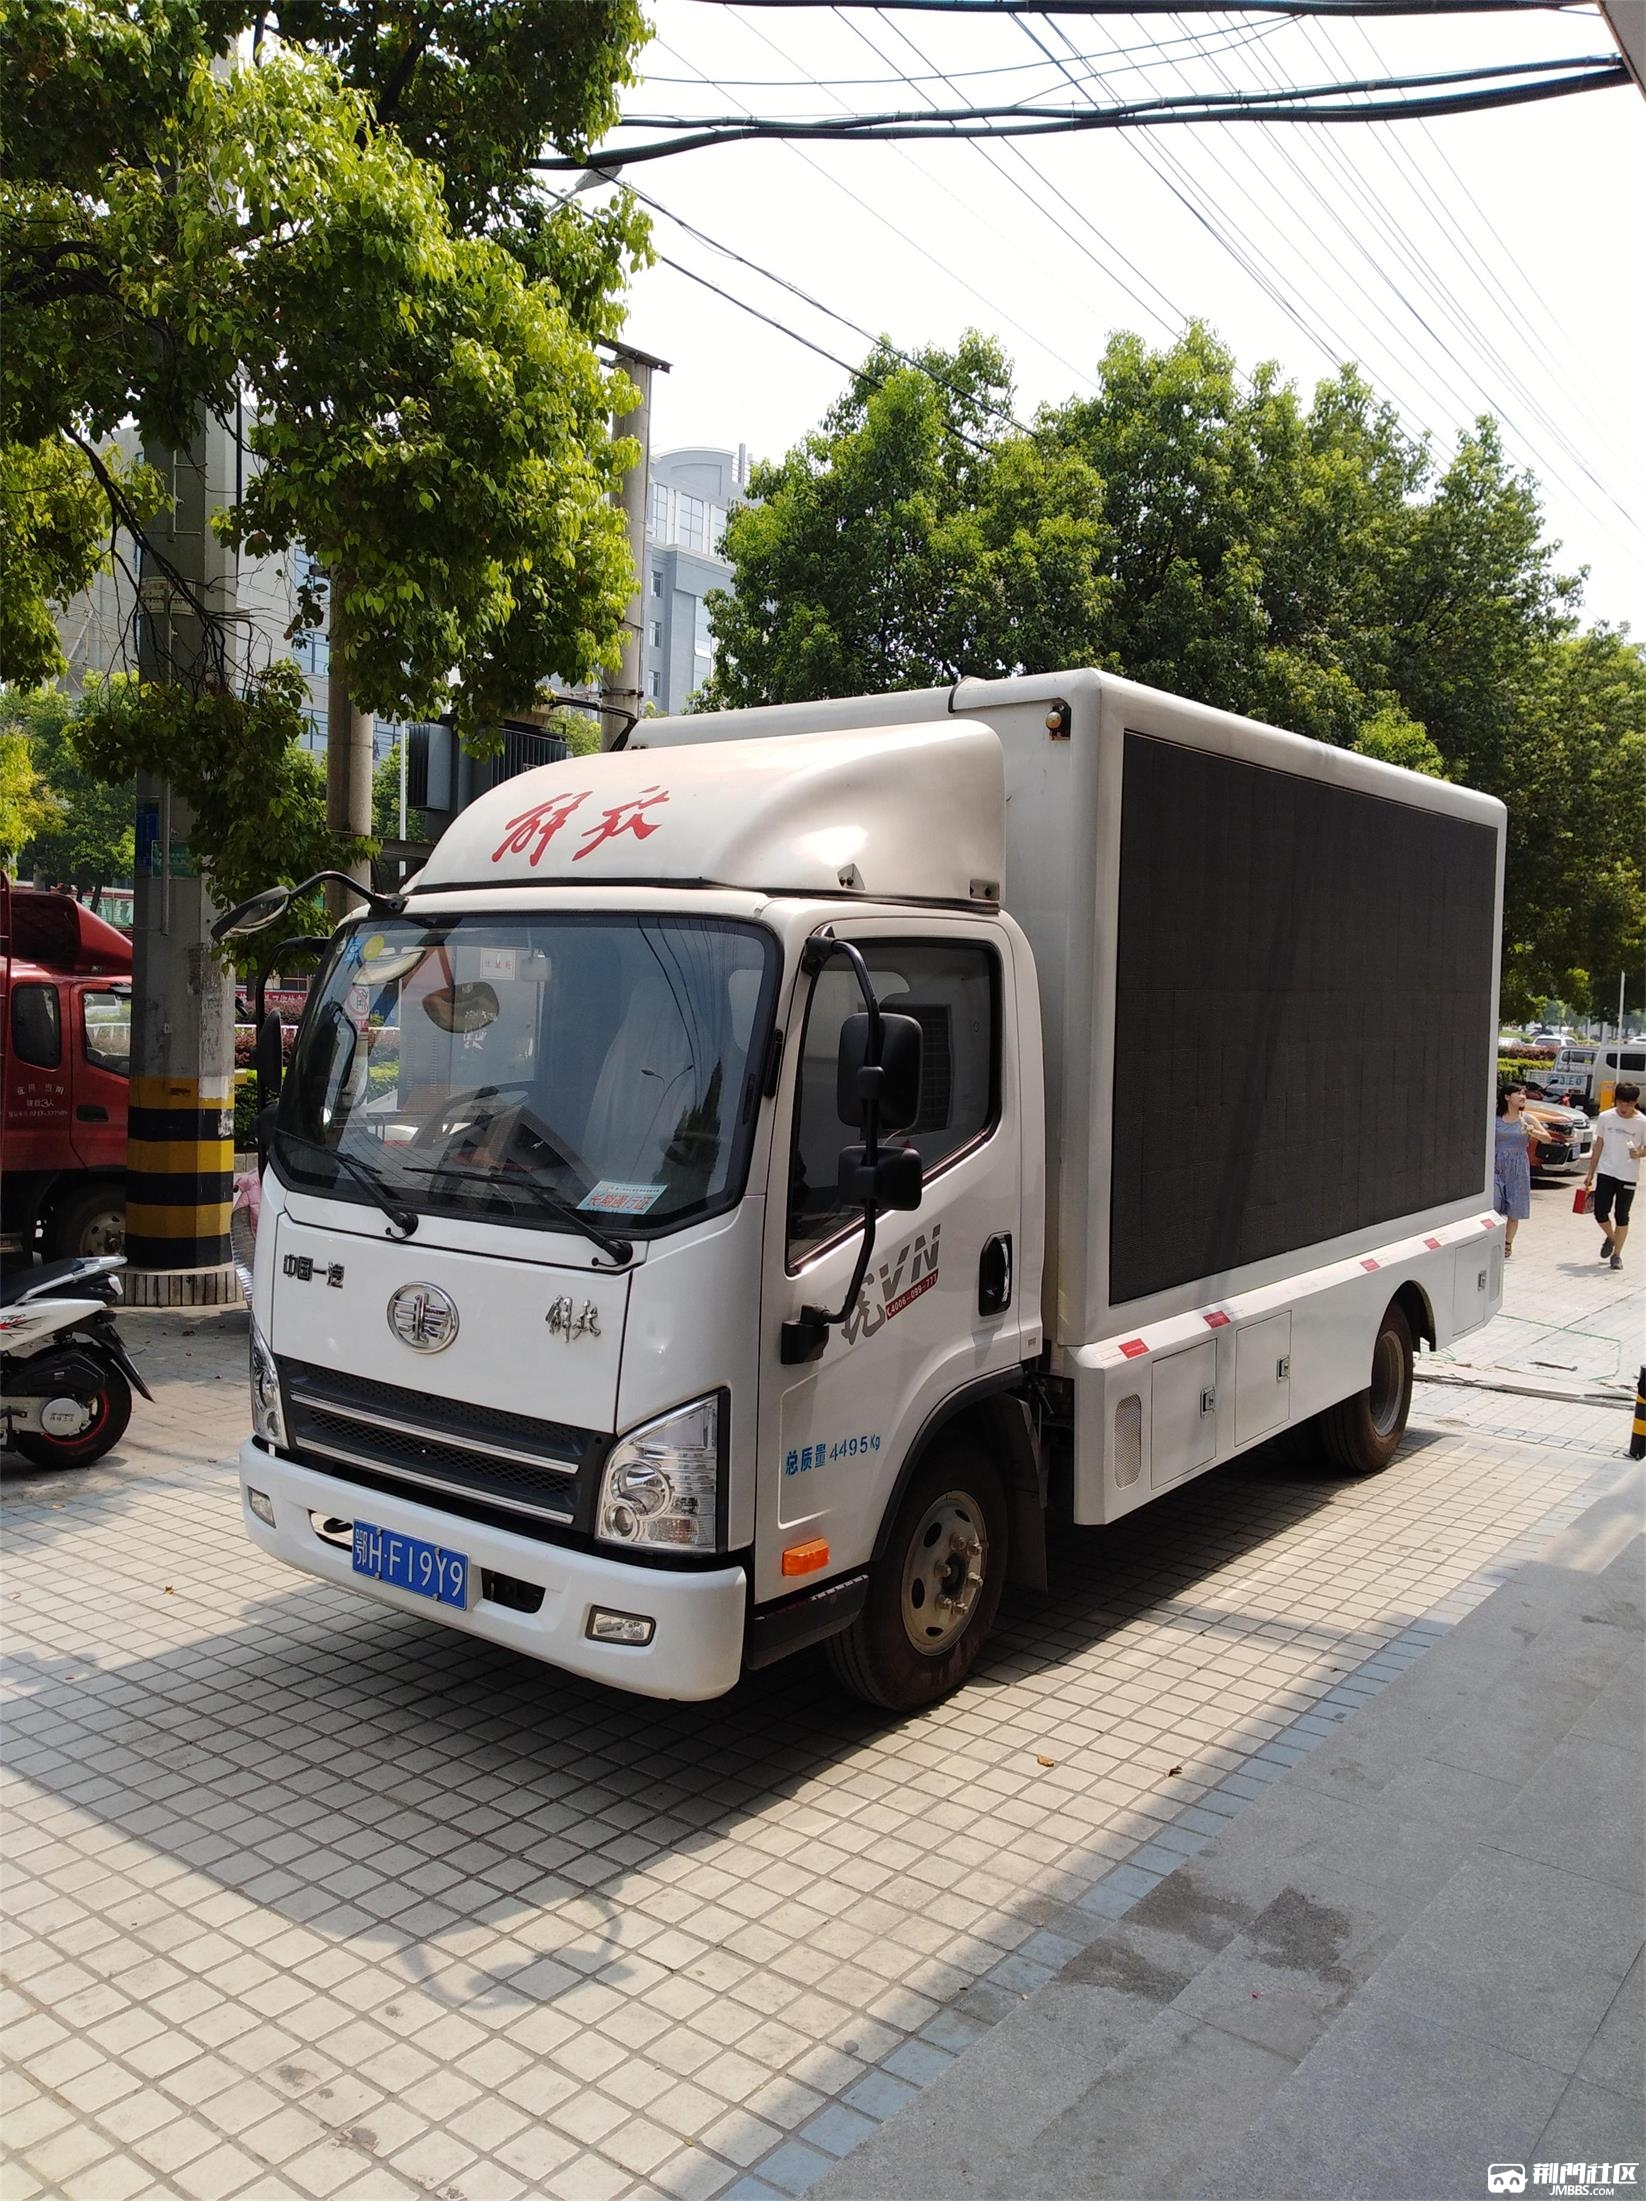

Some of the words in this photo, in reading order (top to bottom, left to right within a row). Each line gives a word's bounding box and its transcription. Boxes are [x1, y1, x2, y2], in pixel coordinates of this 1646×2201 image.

[491, 785, 670, 867] 解放
[283, 1254, 345, 1289] 中国一汽
[545, 1295, 600, 1342] 解放
